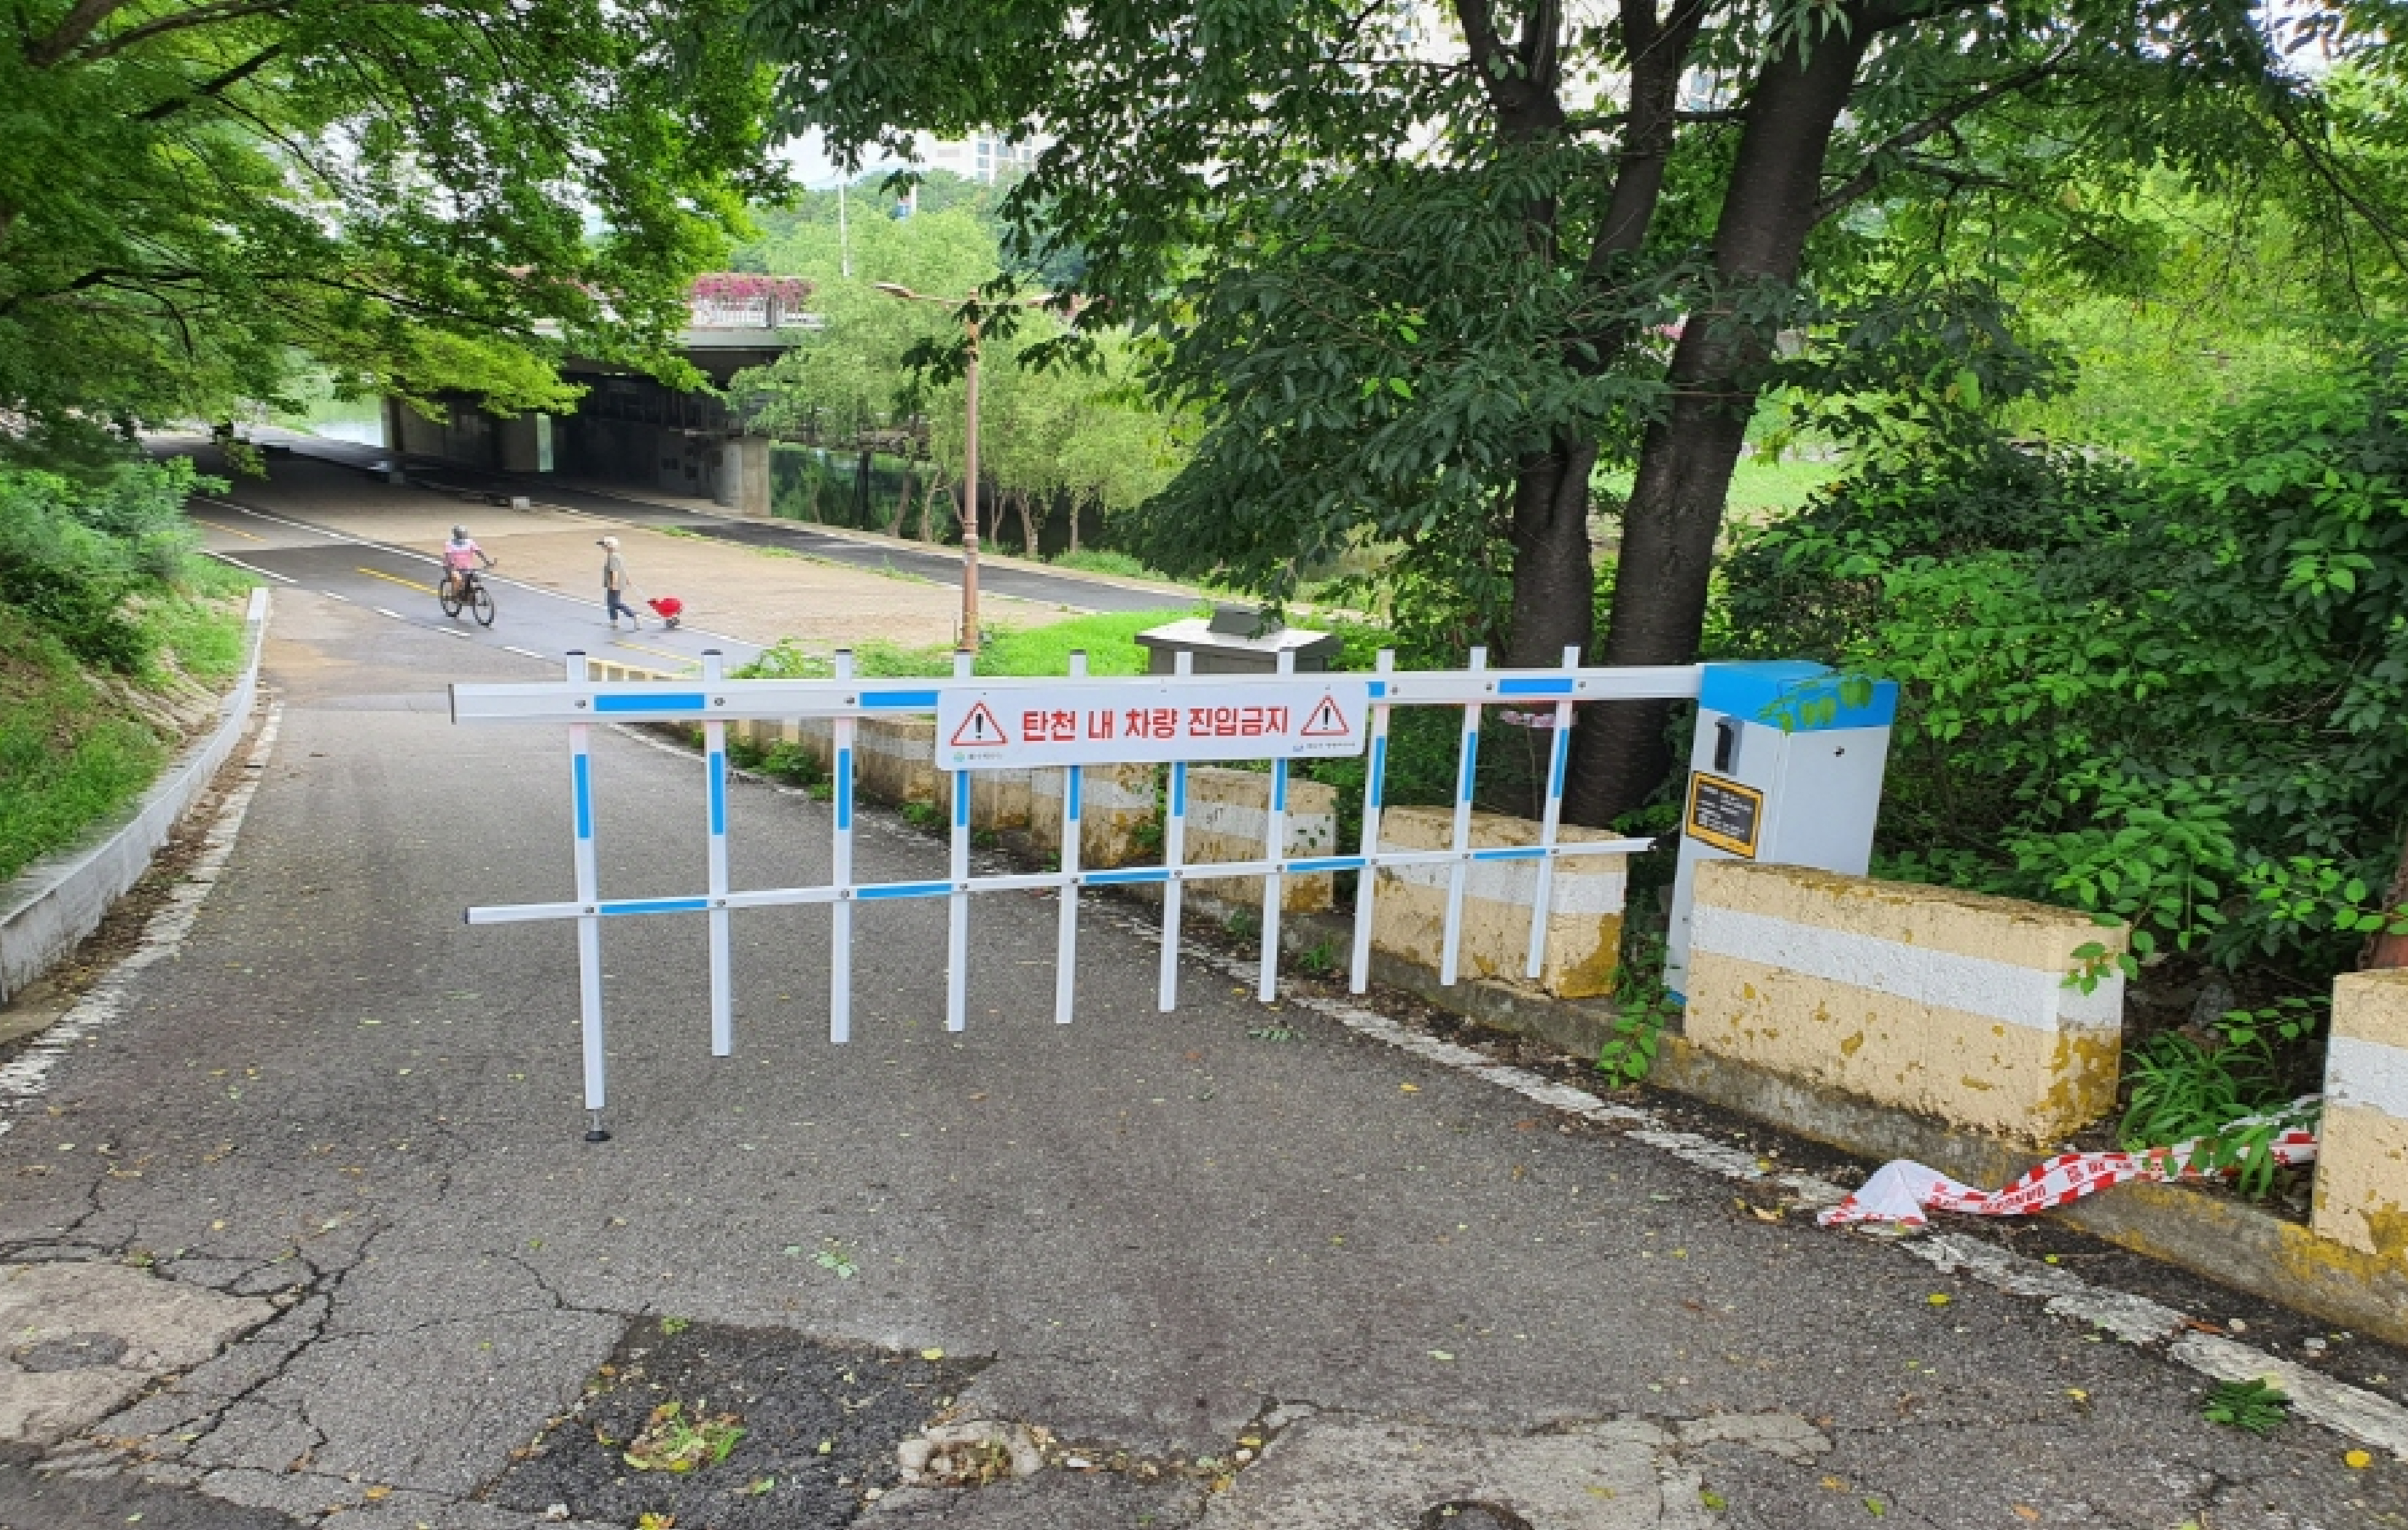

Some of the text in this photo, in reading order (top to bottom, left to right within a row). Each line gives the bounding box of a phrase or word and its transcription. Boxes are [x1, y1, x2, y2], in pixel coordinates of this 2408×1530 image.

[1021, 706, 1288, 741] 탄천 내 차량 진입금지
